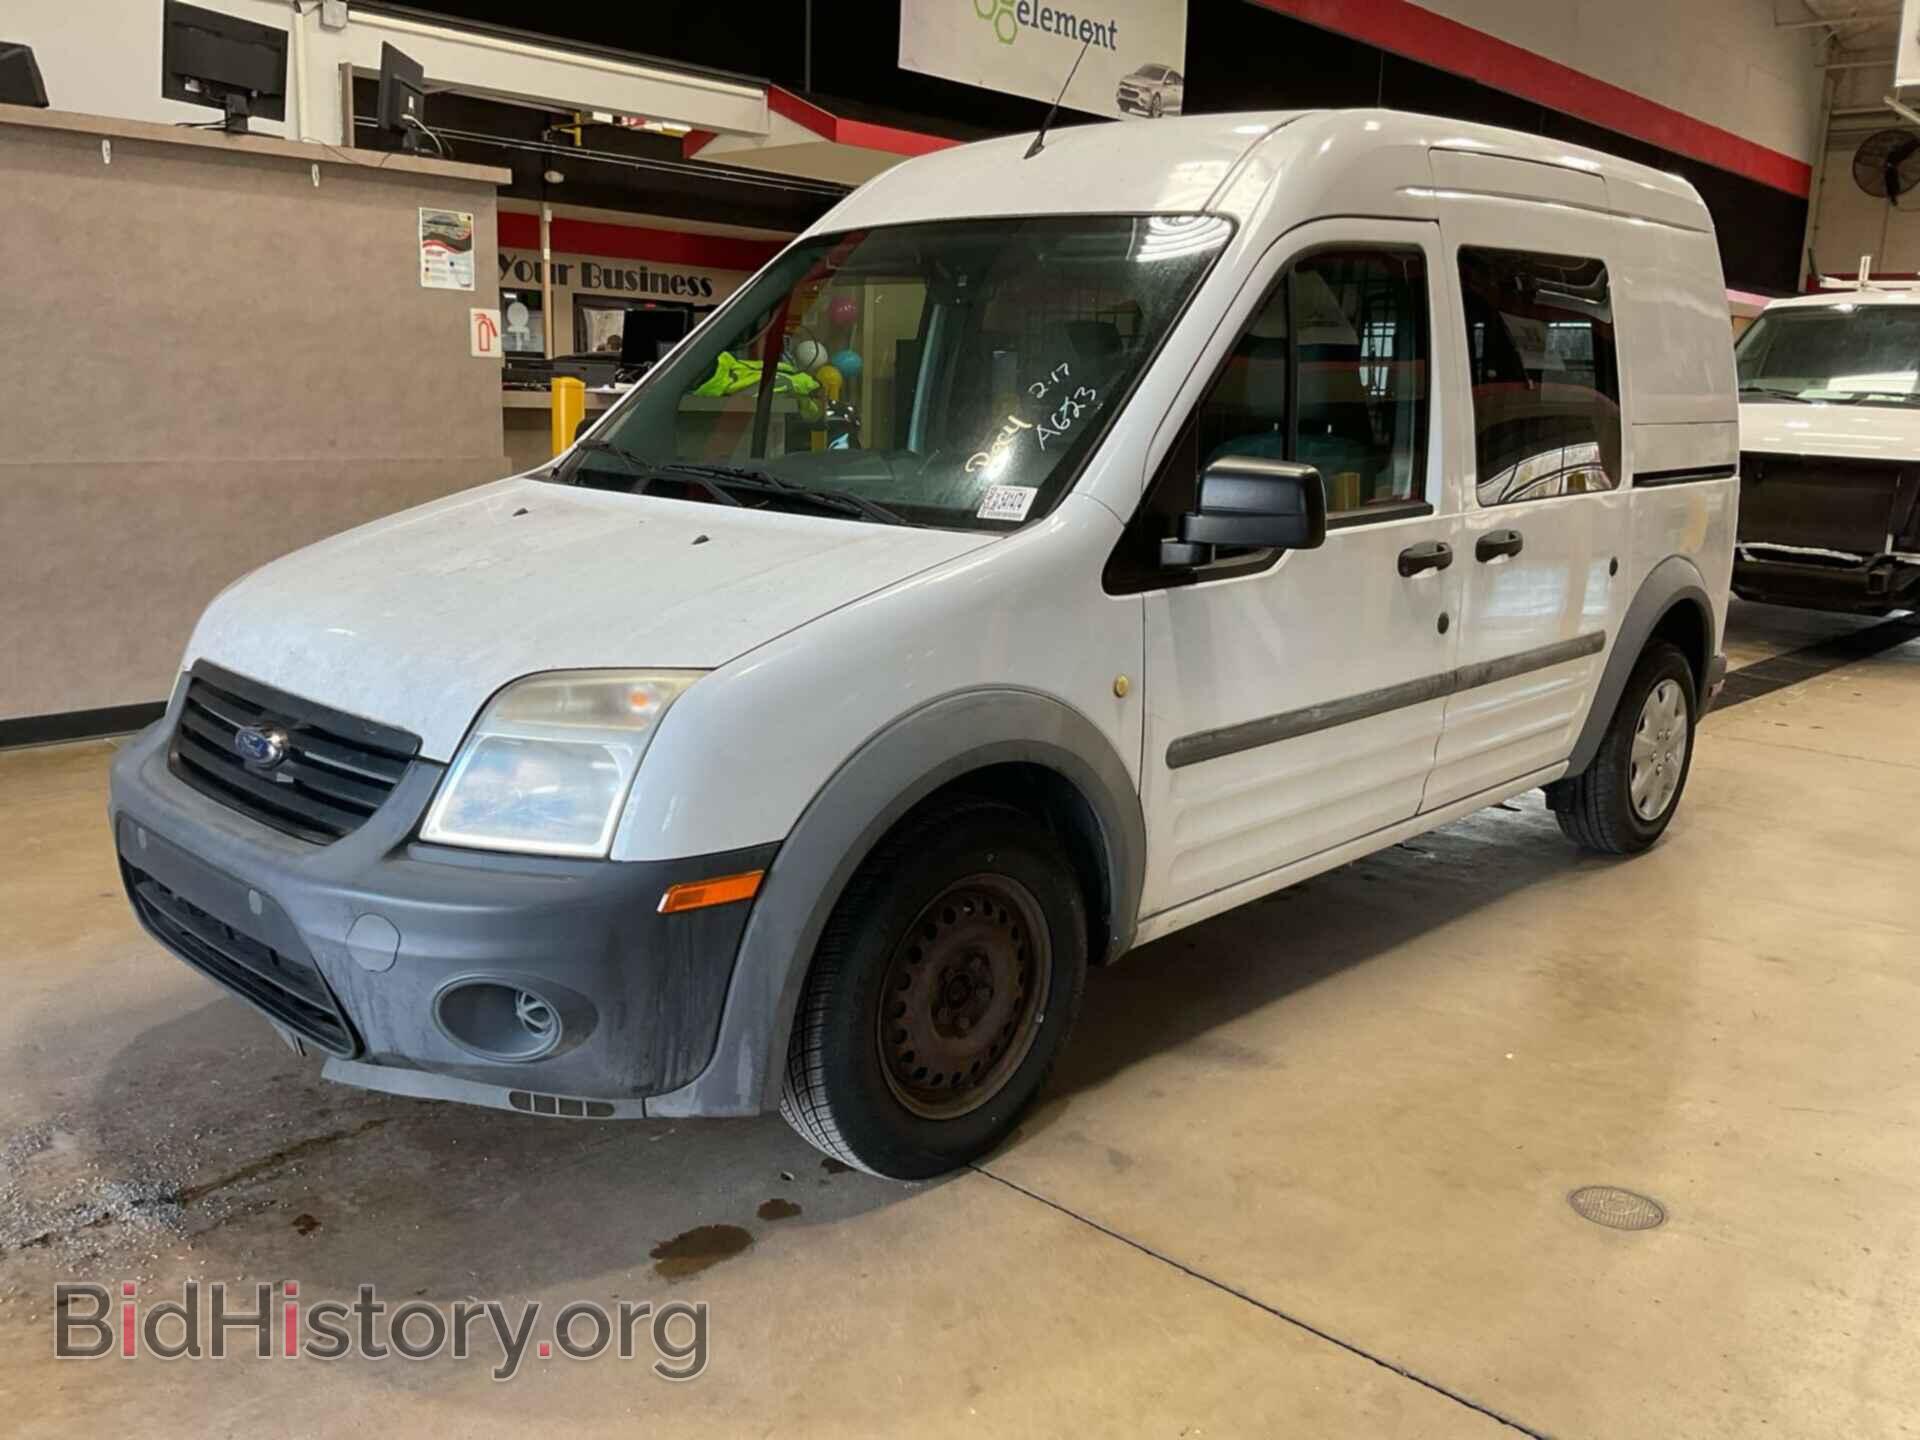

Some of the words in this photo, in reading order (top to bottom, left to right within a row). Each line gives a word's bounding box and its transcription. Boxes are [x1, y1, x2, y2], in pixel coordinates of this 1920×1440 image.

[1017, 0, 1117, 50] element
[499, 253, 574, 286] Your
[581, 262, 713, 297] Business
